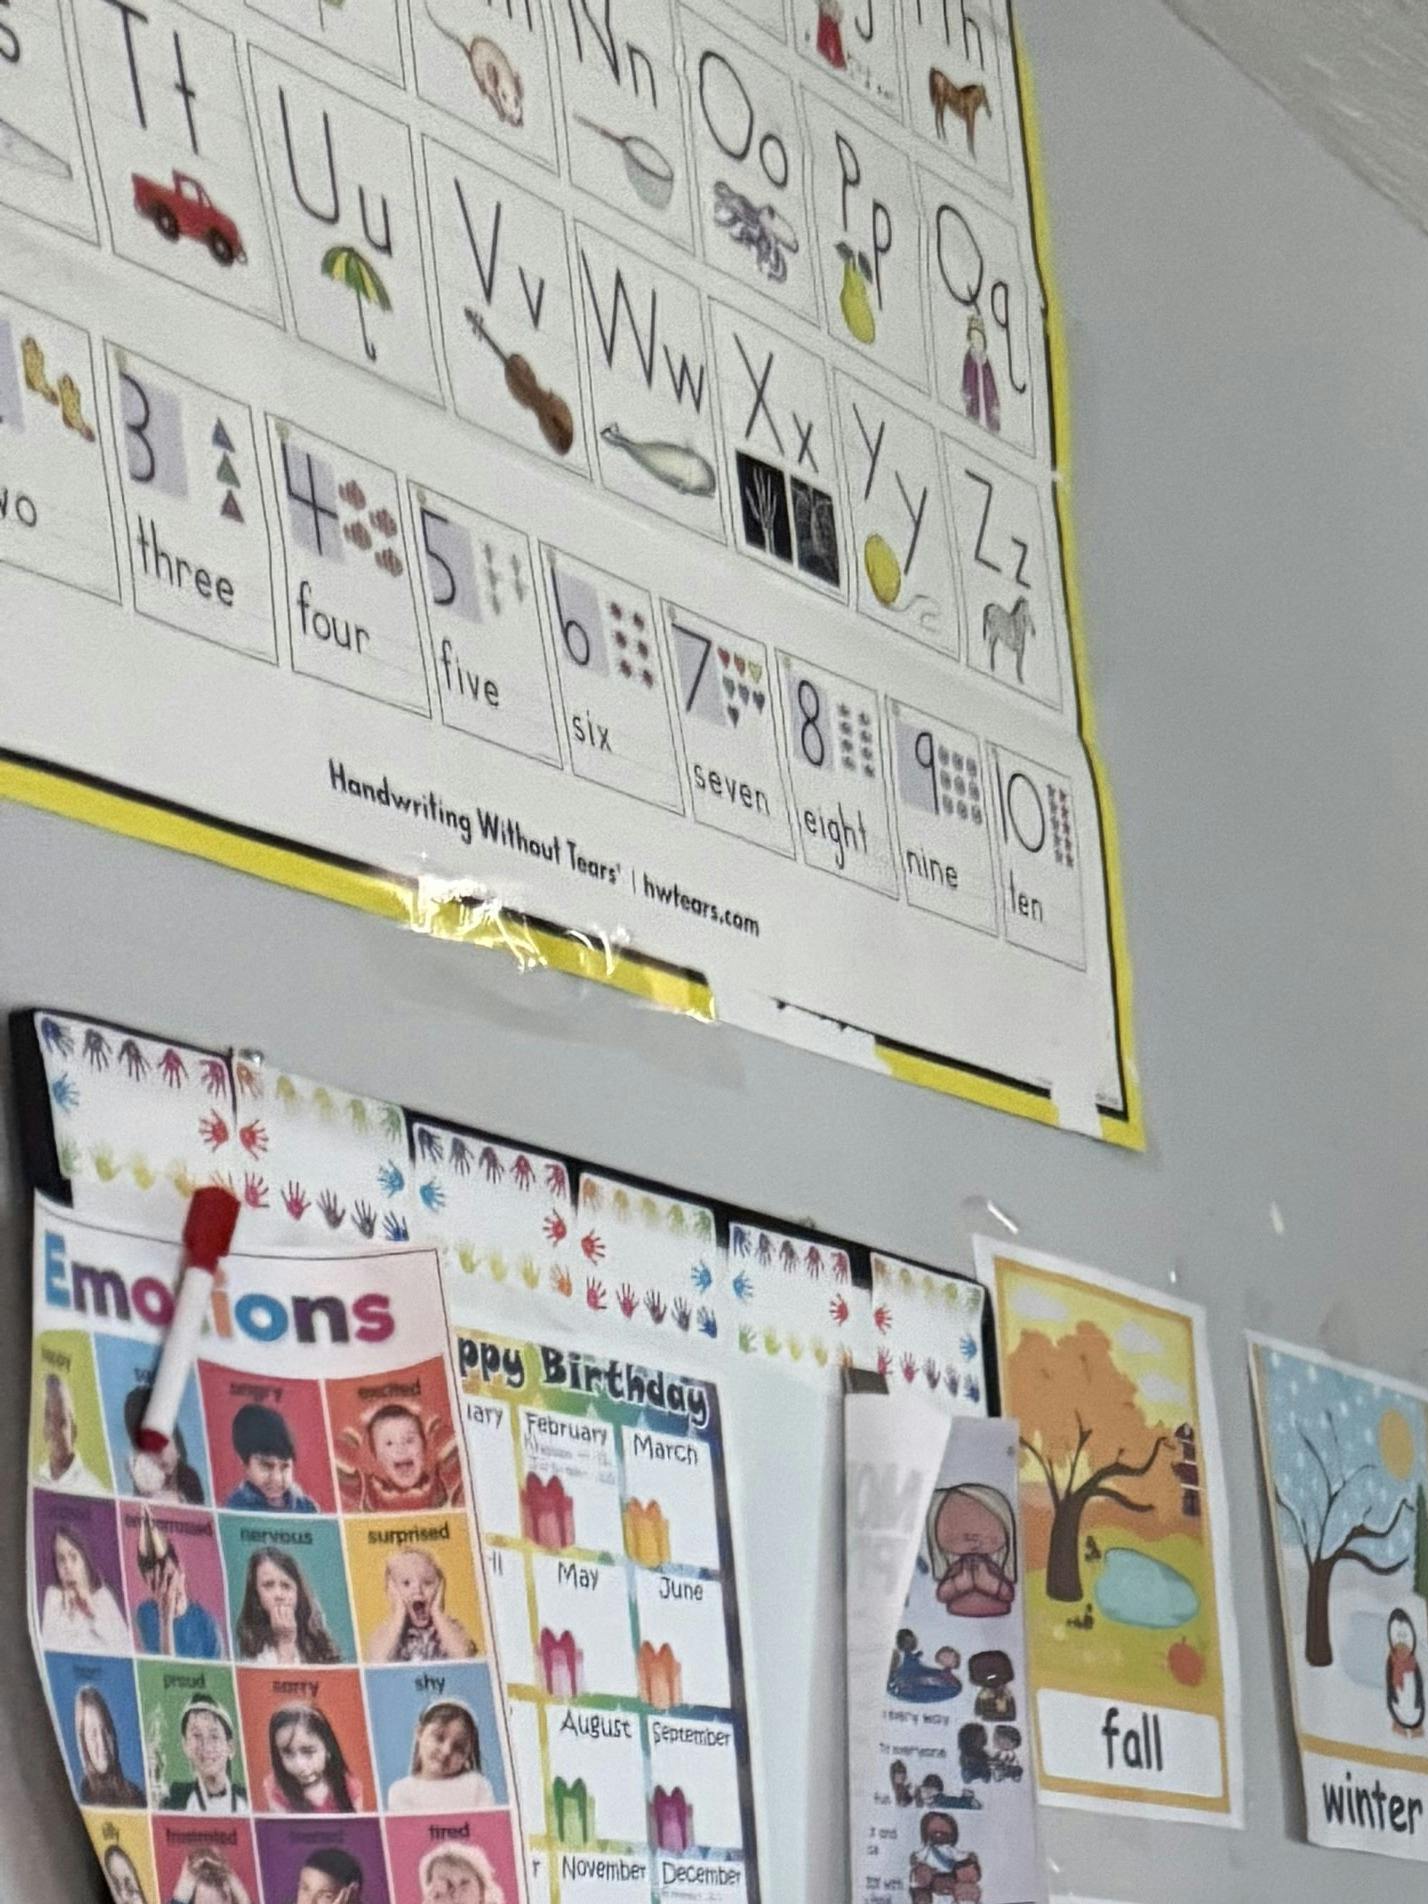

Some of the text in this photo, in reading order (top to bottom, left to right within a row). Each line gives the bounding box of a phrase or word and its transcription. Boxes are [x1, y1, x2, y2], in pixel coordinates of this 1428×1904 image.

[119, 370, 156, 484] 3
[280, 440, 339, 557] 4
[136, 513, 235, 607] three
[420, 506, 456, 606] 5
[296, 580, 370, 654] four
[551, 562, 591, 666] 6
[440, 635, 500, 708] five
[671, 621, 712, 713] 7
[571, 709, 613, 753] six
[797, 678, 826, 768] 8
[692, 763, 771, 817] seven
[914, 731, 940, 816] 9
[994, 746, 1047, 855] 10
[328, 757, 472, 846] Handwriting
[477, 806, 561, 866] Without
[643, 871, 761, 938] hwtears.com
[803, 801, 868, 872] eight
[905, 846, 959, 891] nine
[45, 1229, 395, 1342] Emoions
[541, 1346, 709, 1428] Birthday
[525, 1412, 608, 1446] February
[634, 1433, 698, 1466] March
[368, 1520, 450, 1547] surprised
[557, 1561, 599, 1591] May
[659, 1576, 704, 1601] June
[414, 1671, 446, 1697] shy
[560, 1709, 632, 1742] August
[652, 1721, 731, 1749] September
[1102, 1708, 1163, 1772] fall
[1321, 1772, 1424, 1836] winter
[561, 1858, 647, 1881] November
[661, 1862, 742, 1886] December
